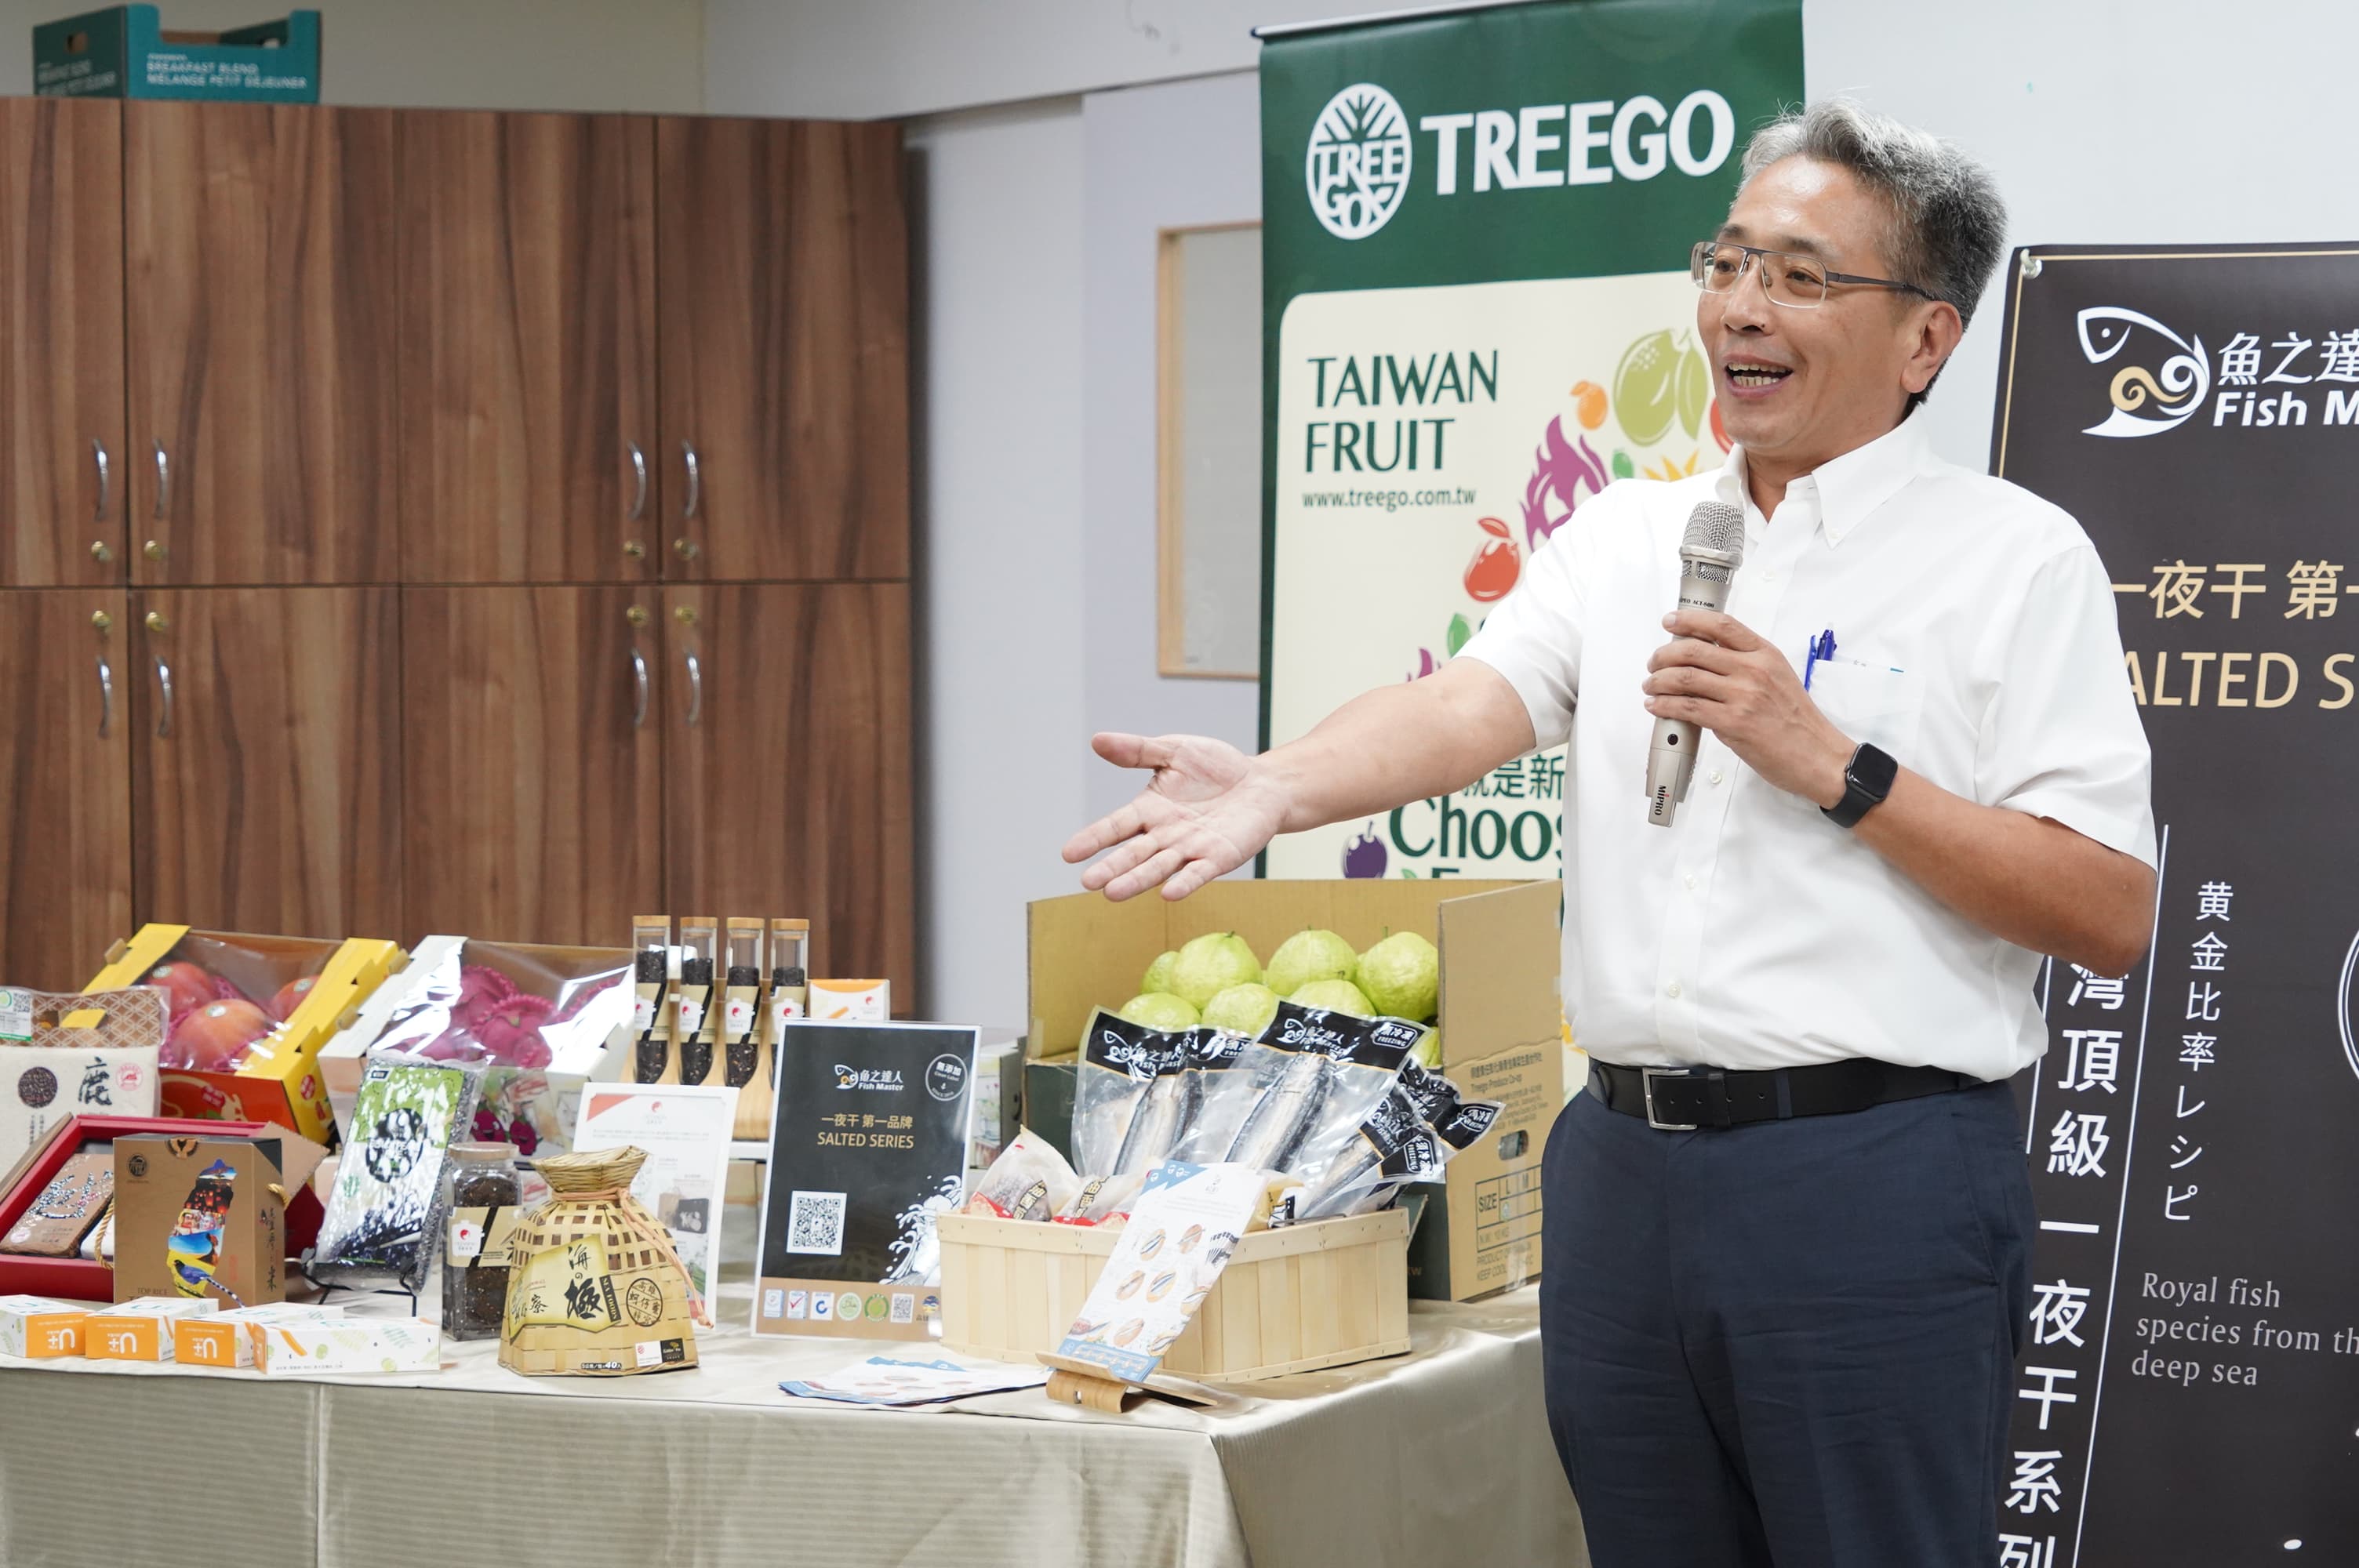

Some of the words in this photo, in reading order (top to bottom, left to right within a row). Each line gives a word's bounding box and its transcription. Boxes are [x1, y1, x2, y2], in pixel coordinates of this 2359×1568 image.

[1419, 89, 1735, 195] TREEGO
[1315, 140, 1405, 190] TREE
[1307, 350, 1499, 408] TAIWAN
[2212, 390, 2307, 427] Fish
[1305, 418, 1455, 473] FRUIT
[1302, 488, 1477, 512] www.treego.com.tw
[2284, 560, 2359, 620] 第
[1390, 794, 1562, 862] Choo
[858, 1082, 875, 1091] Fish
[875, 1082, 904, 1091] Master
[860, 1069, 904, 1083] 魚之達人
[821, 1112, 860, 1127] 一夜干
[863, 1113, 914, 1130] 第一品牌
[817, 1131, 866, 1147] SALTED
[869, 1134, 914, 1149] SERIES
[1478, 1192, 1498, 1213] SIZE
[2142, 1272, 2219, 1307] Royal
[2229, 1277, 2281, 1308] fish
[2135, 1315, 2241, 1345] species
[2252, 1319, 2321, 1352] from
[2131, 1349, 2201, 1387] deep
[2212, 1361, 2259, 1385] sea
